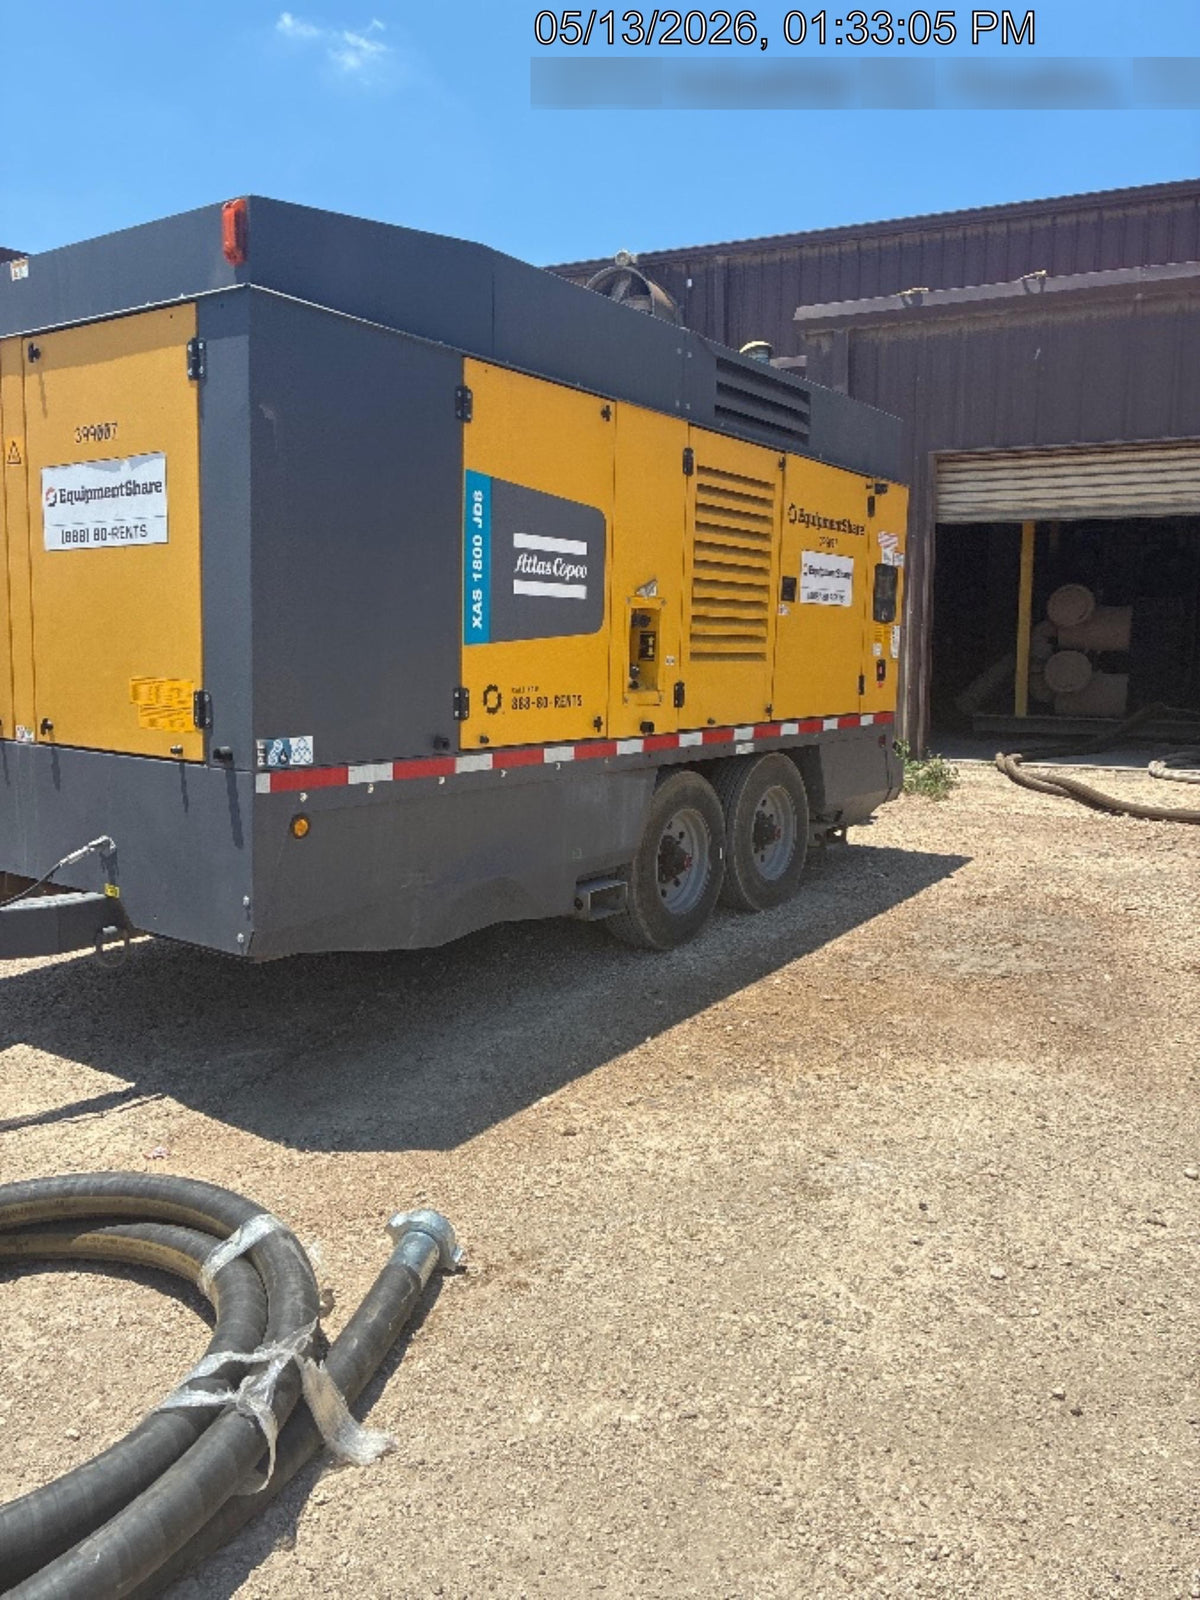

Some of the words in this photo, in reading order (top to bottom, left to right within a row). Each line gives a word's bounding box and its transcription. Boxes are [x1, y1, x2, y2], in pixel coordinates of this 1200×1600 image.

[58, 479, 163, 505] EquipmentShare
[472, 535, 483, 582] 1800
[513, 553, 552, 575] Atlas
[552, 557, 588, 582] Copco
[472, 588, 483, 630] XAS
